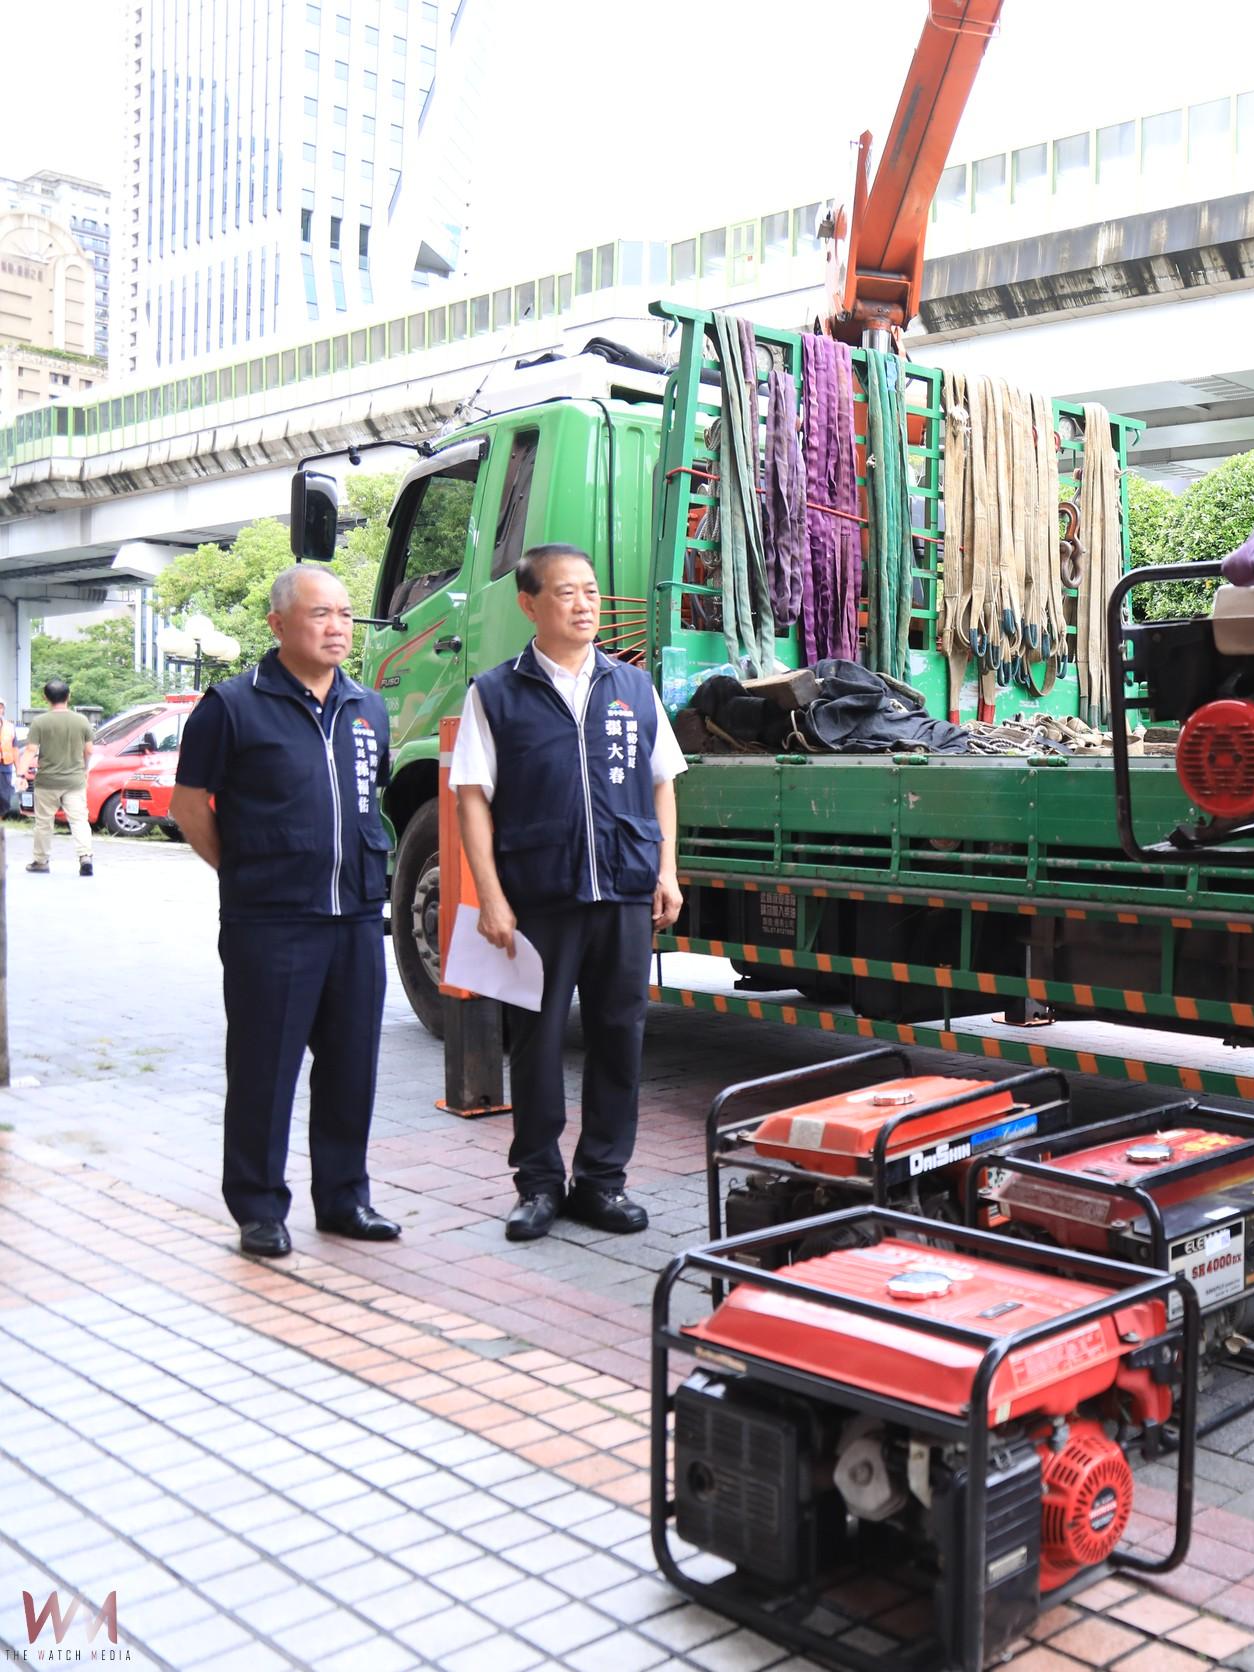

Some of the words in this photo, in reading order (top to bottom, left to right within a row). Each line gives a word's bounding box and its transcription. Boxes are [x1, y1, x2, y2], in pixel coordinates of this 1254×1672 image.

[381, 676, 400, 688] FUSO
[605, 720, 625, 784] 張大春
